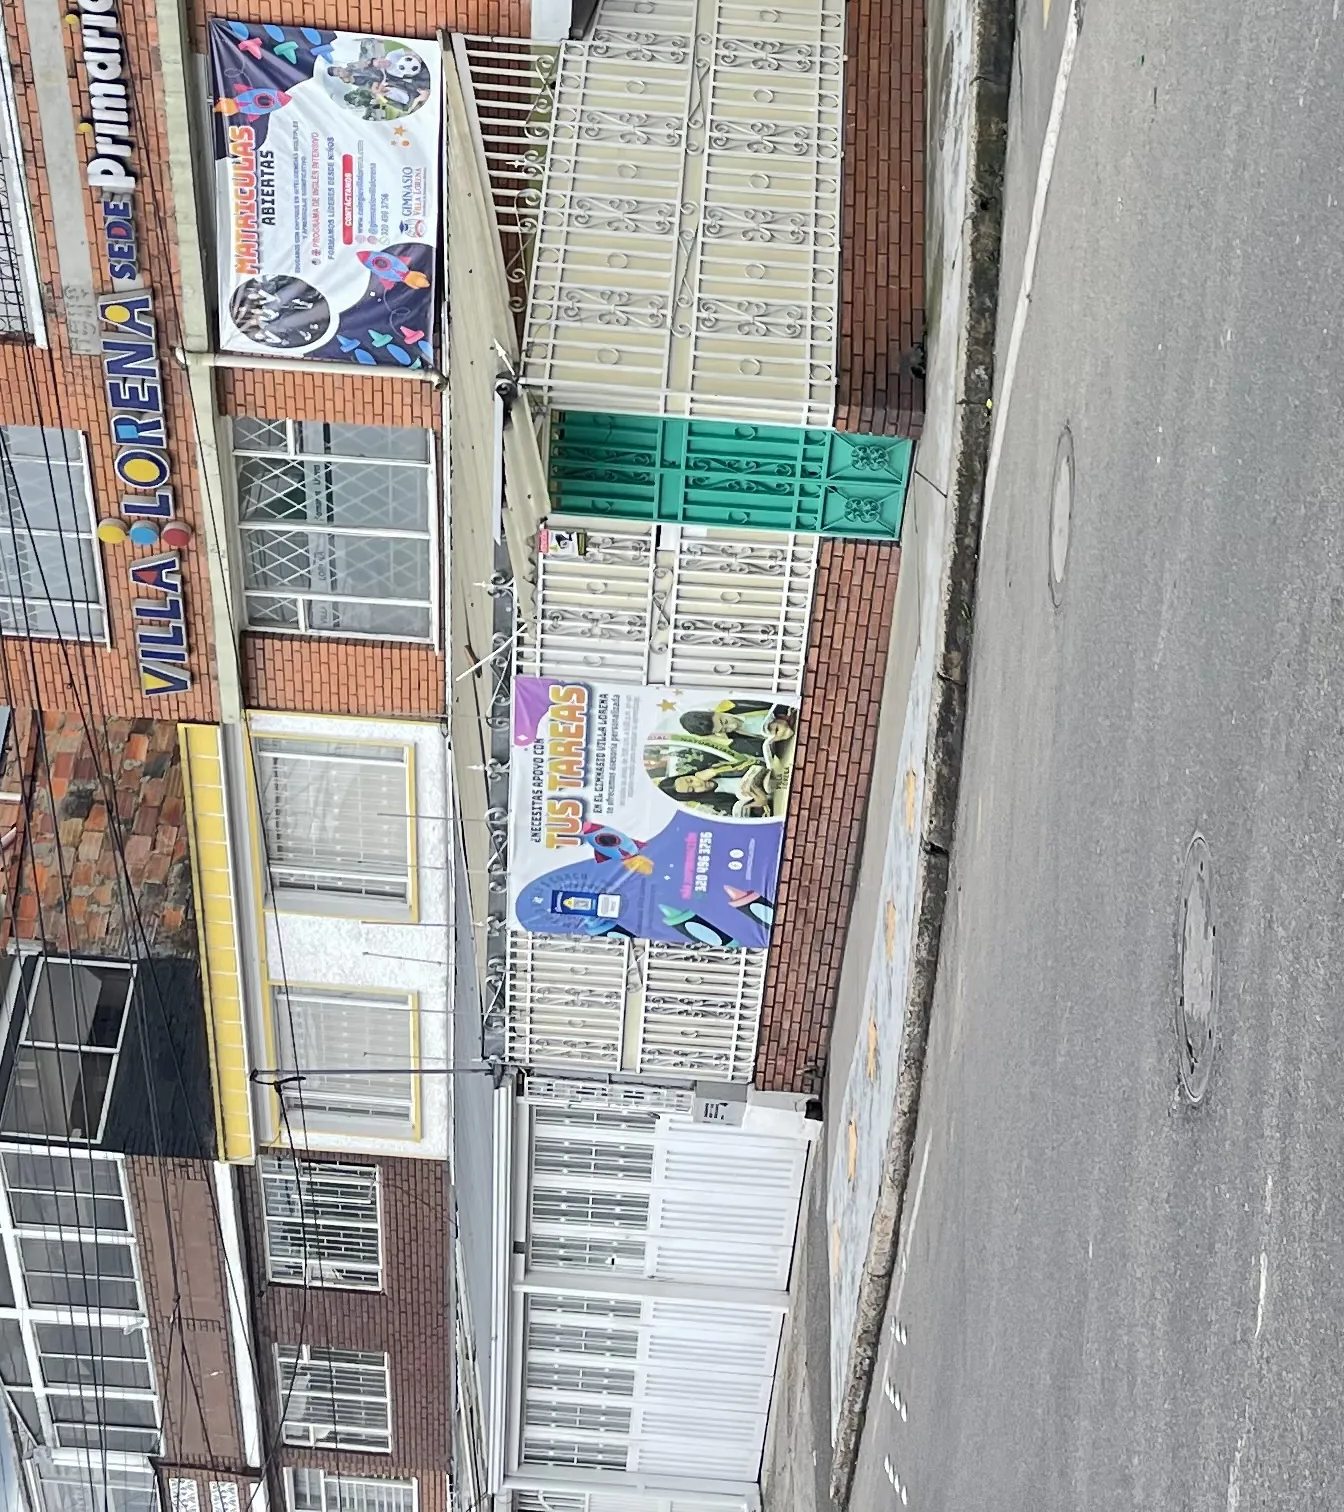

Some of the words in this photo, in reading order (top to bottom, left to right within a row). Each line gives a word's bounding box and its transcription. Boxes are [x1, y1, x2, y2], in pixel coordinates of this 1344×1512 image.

[229, 125, 259, 275] MATRICULAS
[260, 150, 276, 226] ABIERTAS
[402, 167, 413, 217] GIMNASIO
[101, 196, 139, 280] SEDE
[96, 289, 175, 519] LORENA
[128, 551, 192, 696] VILLA
[597, 693, 609, 725] LORENA
[532, 738, 544, 755] CON
[546, 683, 589, 791] TAREAS
[596, 726, 607, 751] VILLA
[531, 757, 544, 788] APOYO
[545, 799, 584, 849] TUS
[694, 874, 708, 892] 320
